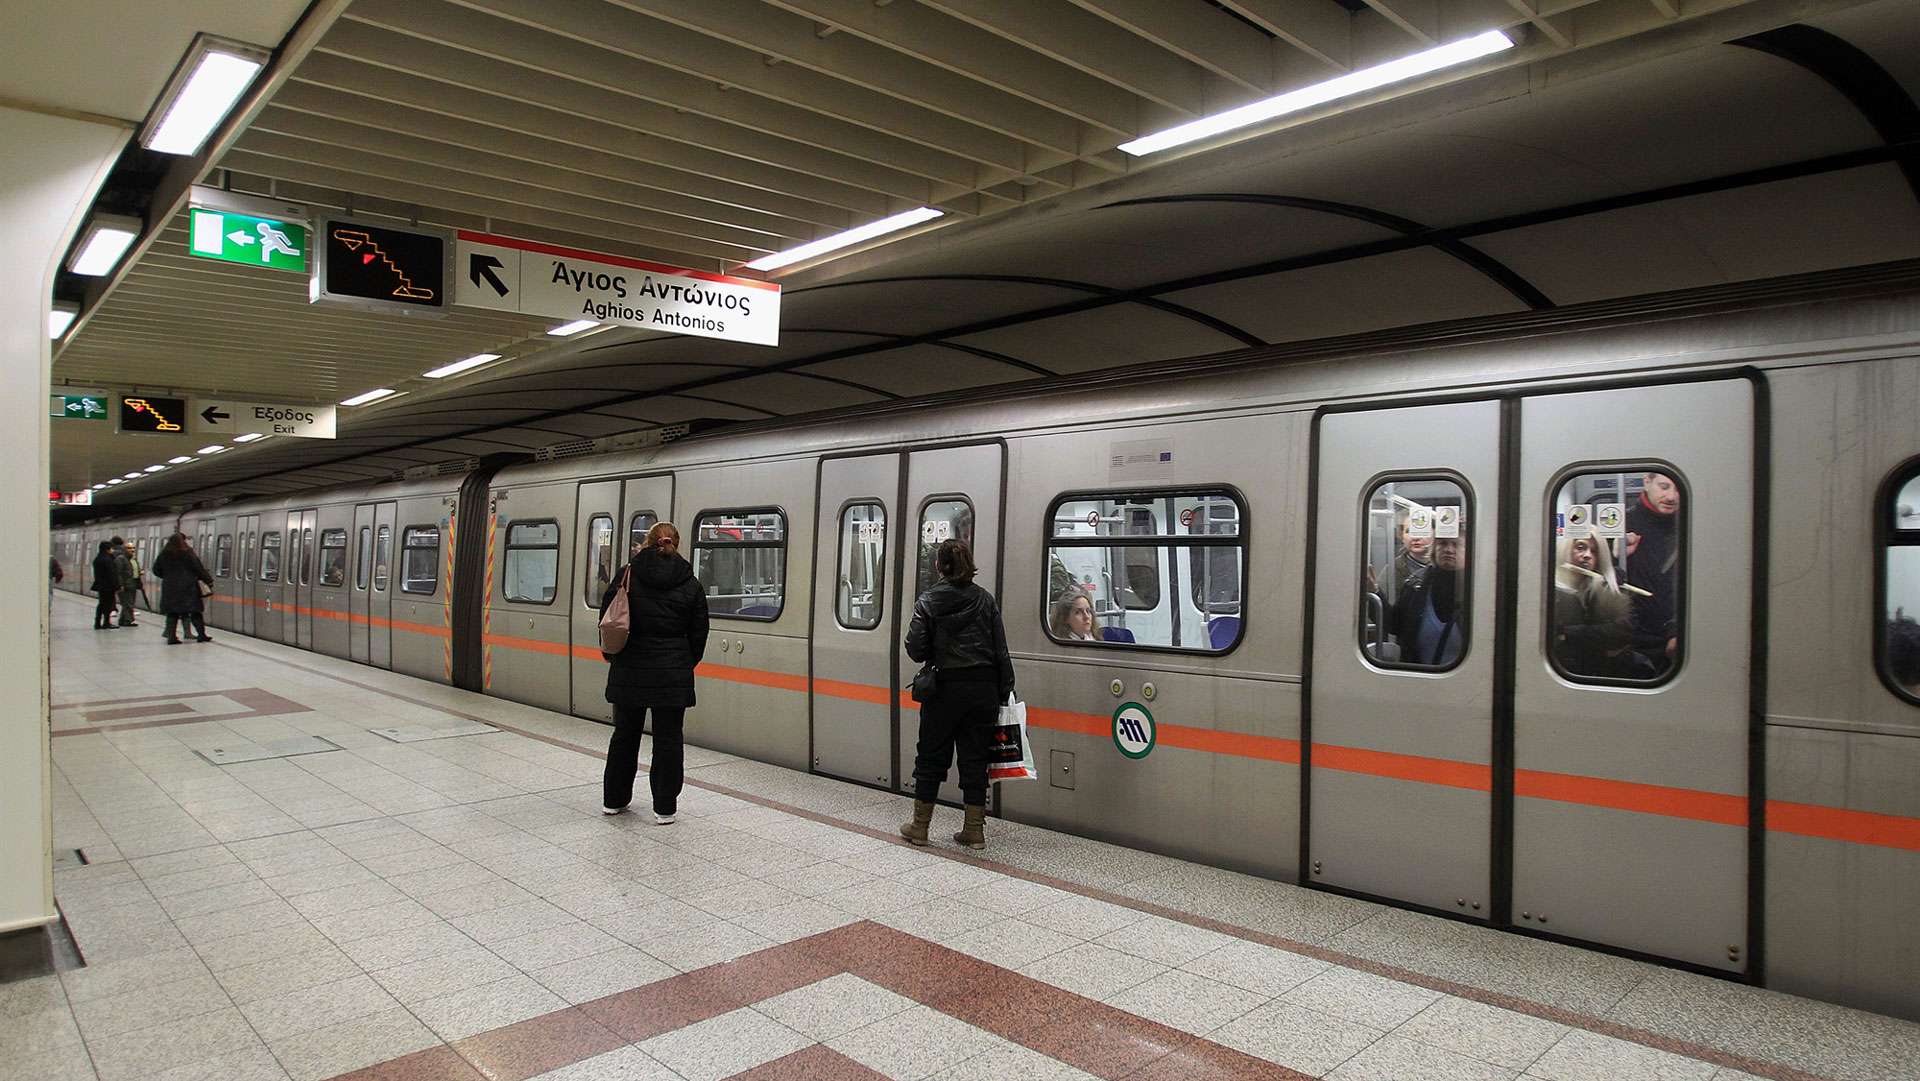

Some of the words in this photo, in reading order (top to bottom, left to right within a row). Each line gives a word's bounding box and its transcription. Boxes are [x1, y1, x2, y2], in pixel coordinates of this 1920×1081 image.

[551, 260, 626, 298] Άγιος
[640, 275, 750, 316] Αντώνιος
[582, 299, 644, 320] Aghios
[652, 308, 725, 332] Antonios
[252, 406, 314, 424] Έξοδος
[273, 424, 295, 433] Exit
